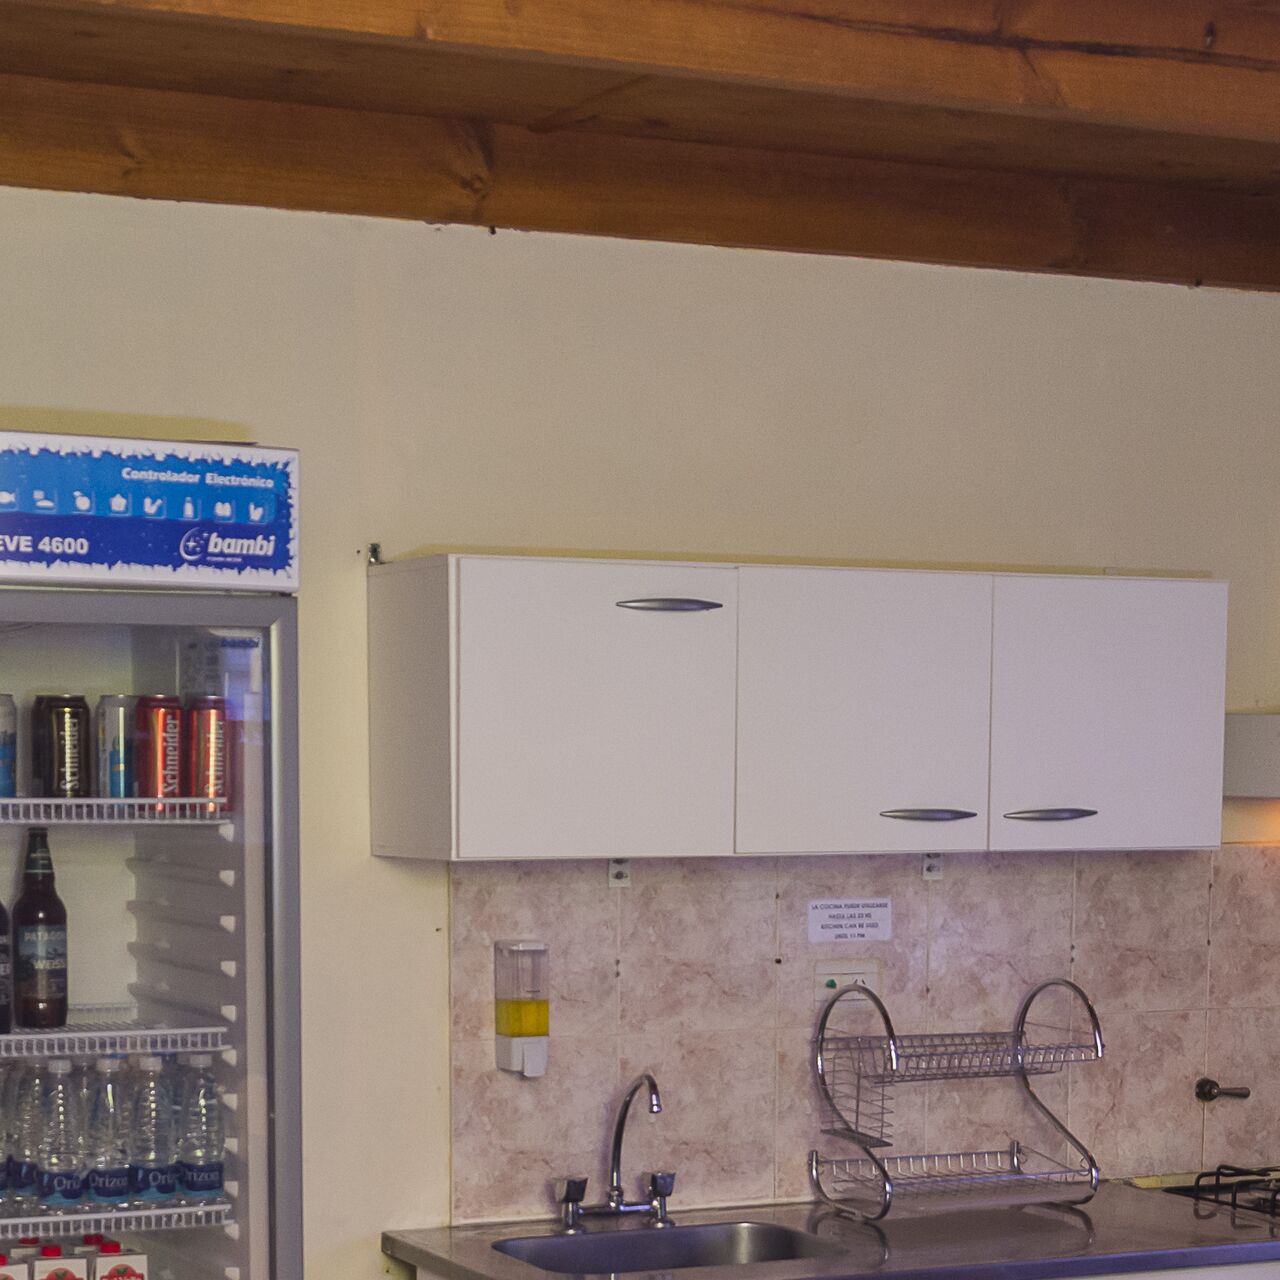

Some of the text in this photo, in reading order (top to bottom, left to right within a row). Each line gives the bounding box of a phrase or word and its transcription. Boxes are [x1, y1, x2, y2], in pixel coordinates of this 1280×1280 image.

[121, 467, 274, 488] Controlador Electrónico
[37, 536, 89, 555] 4600
[207, 532, 276, 556] bambi
[163, 714, 179, 793] Schneider
